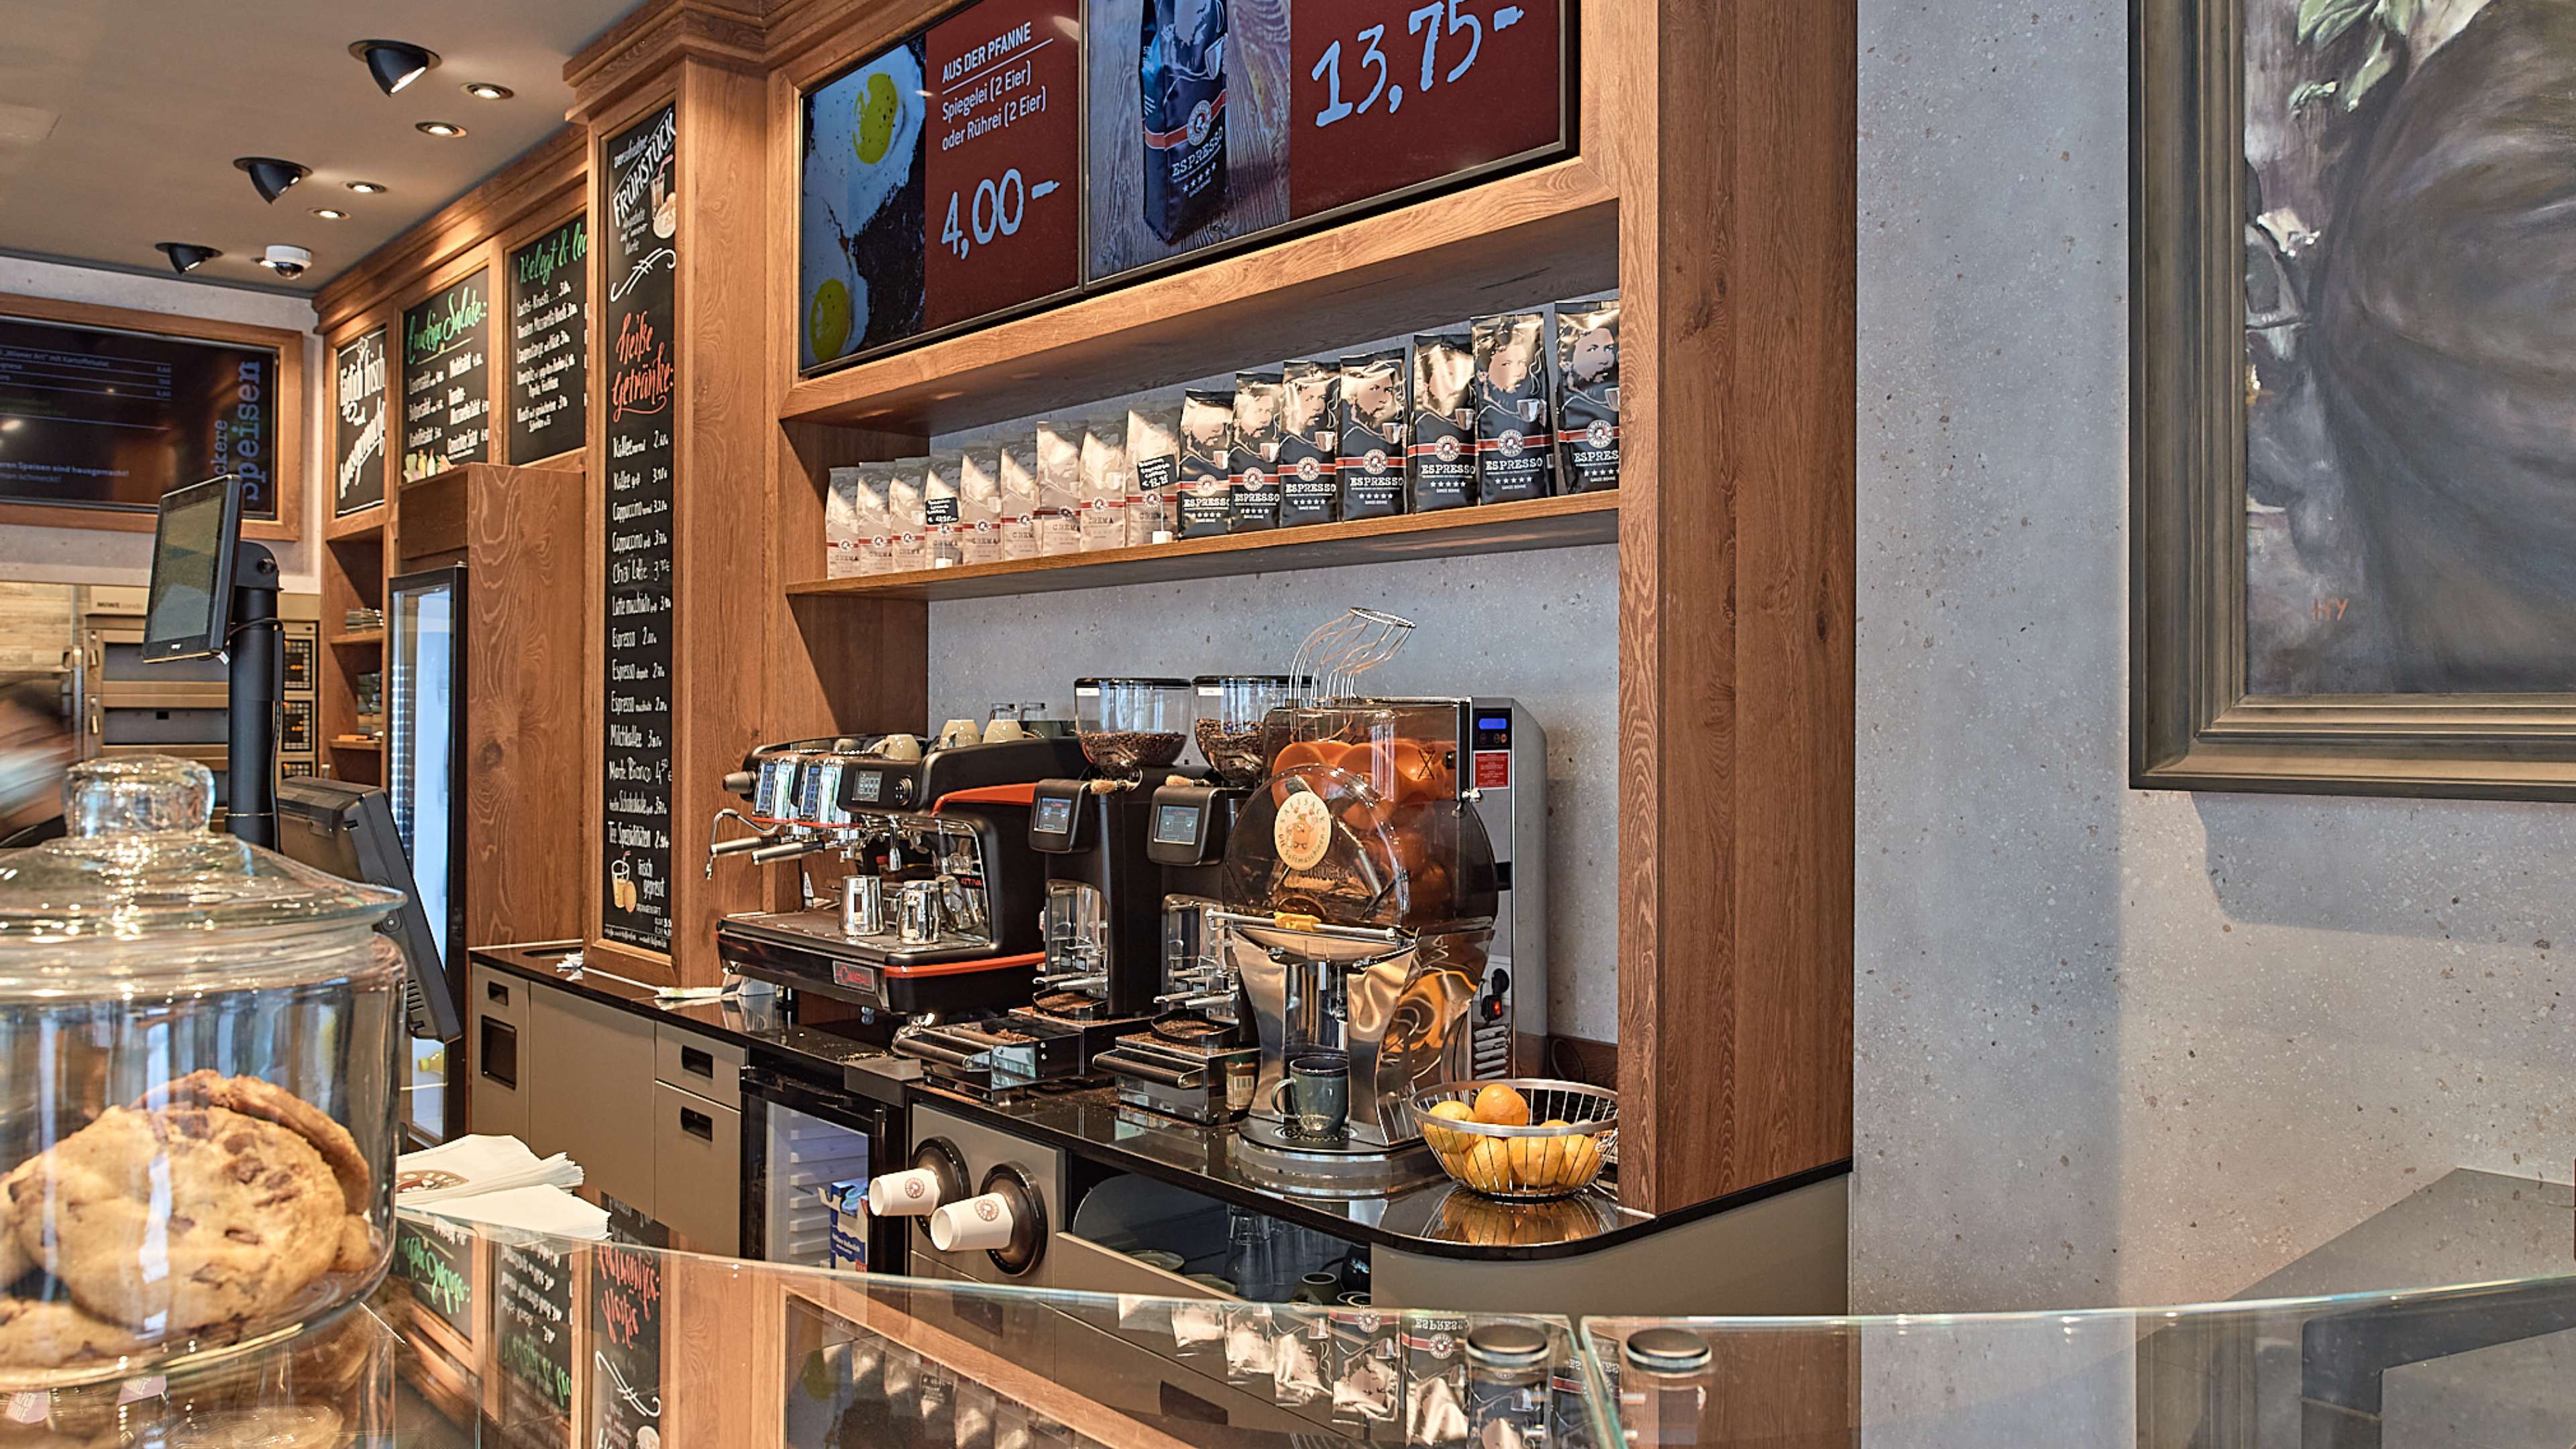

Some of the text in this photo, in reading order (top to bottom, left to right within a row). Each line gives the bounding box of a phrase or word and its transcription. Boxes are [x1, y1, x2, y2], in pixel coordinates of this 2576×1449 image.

[942, 21, 1032, 83] AUS DER PFANNE
[942, 83, 988, 123] Spiegelei
[1005, 68, 1032, 93] Eier)
[942, 127, 964, 152] oder
[967, 111, 1002, 141] Rührei
[1020, 87, 1047, 116] Eier)
[613, 113, 676, 227] FRÜHSTÜCK
[1172, 126, 1224, 176] ESPRESSO
[443, 286, 487, 341] Salate:
[211, 419, 229, 476] ckere
[1421, 464, 1475, 475] ESPRESSO
[1485, 457, 1543, 470] ESPRESSO
[1574, 450, 1618, 463] ESPRES
[1234, 492, 1280, 503] ESPRESSO
[1285, 482, 1336, 494] ESPRESSO
[1350, 476, 1404, 487] ESPRESSO
